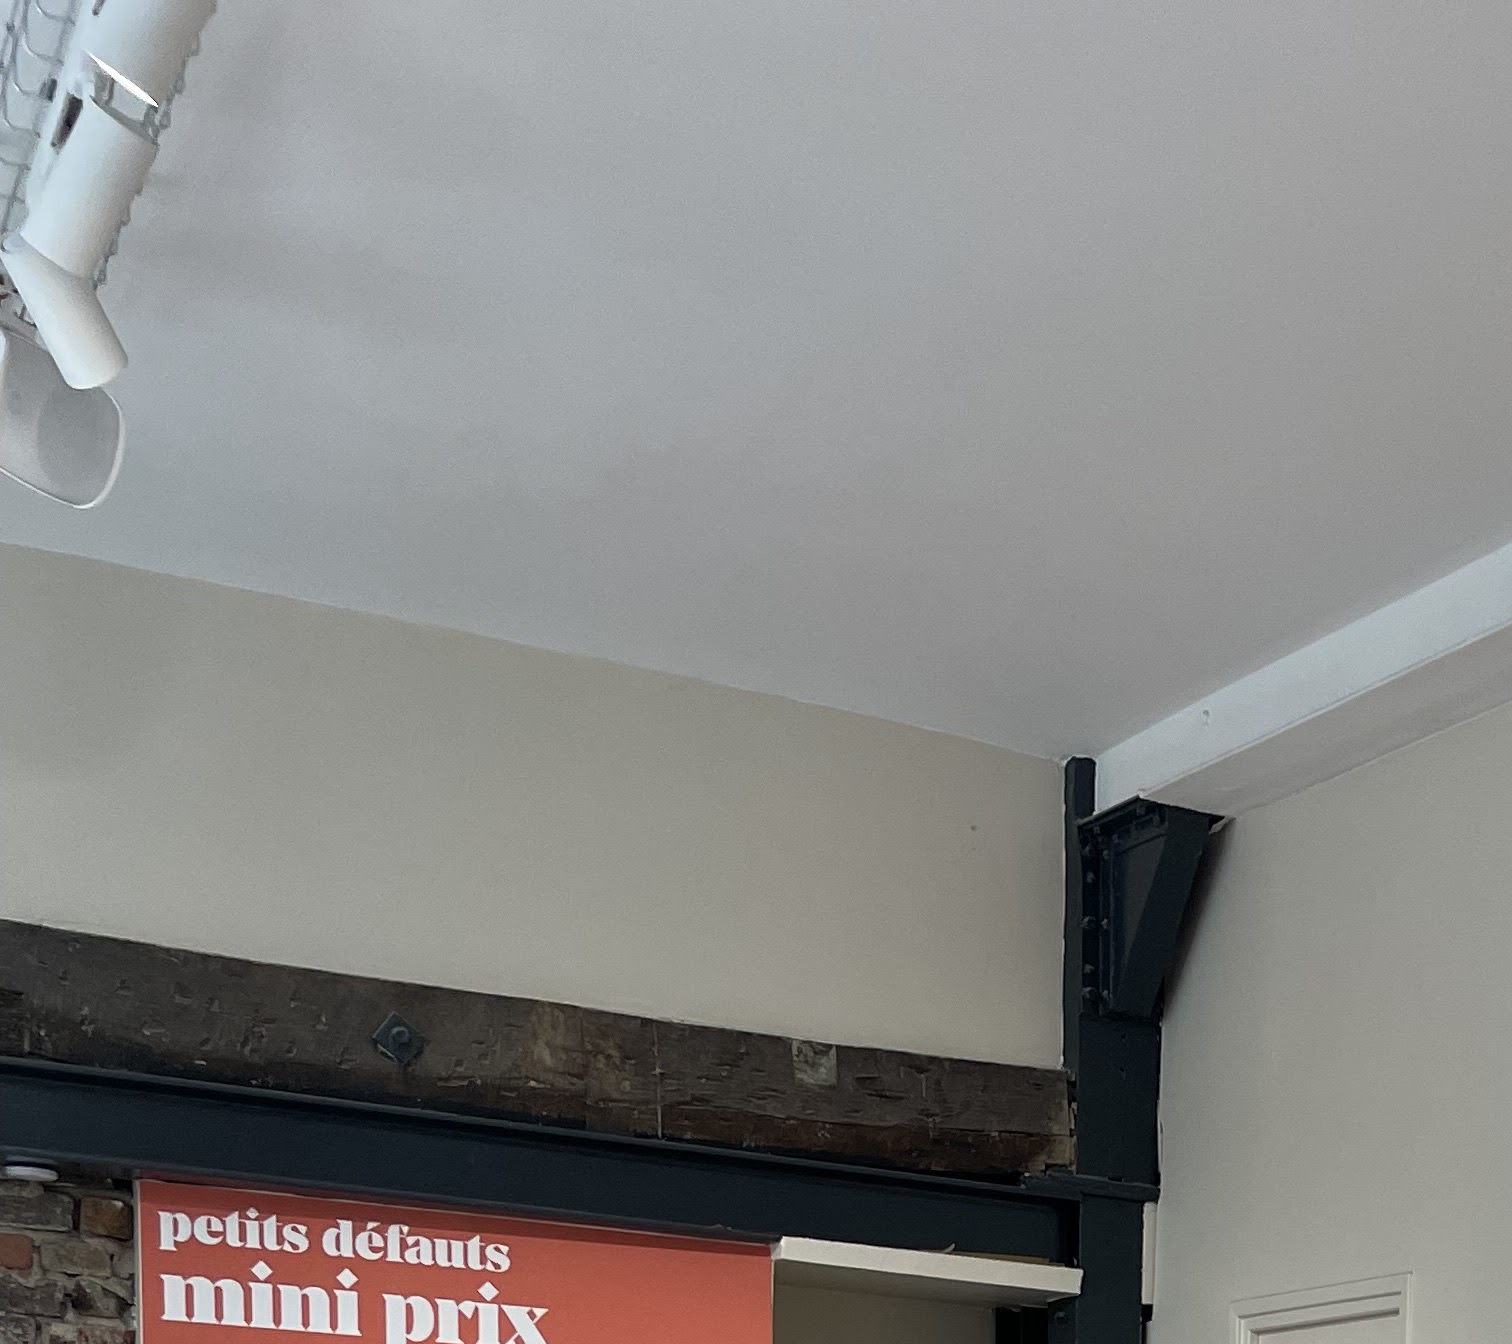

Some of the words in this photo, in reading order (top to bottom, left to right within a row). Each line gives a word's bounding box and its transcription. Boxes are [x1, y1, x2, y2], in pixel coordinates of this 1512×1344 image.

[157, 1207, 310, 1253] petits
[322, 1219, 511, 1273] défauts
[160, 1260, 362, 1336] mini
